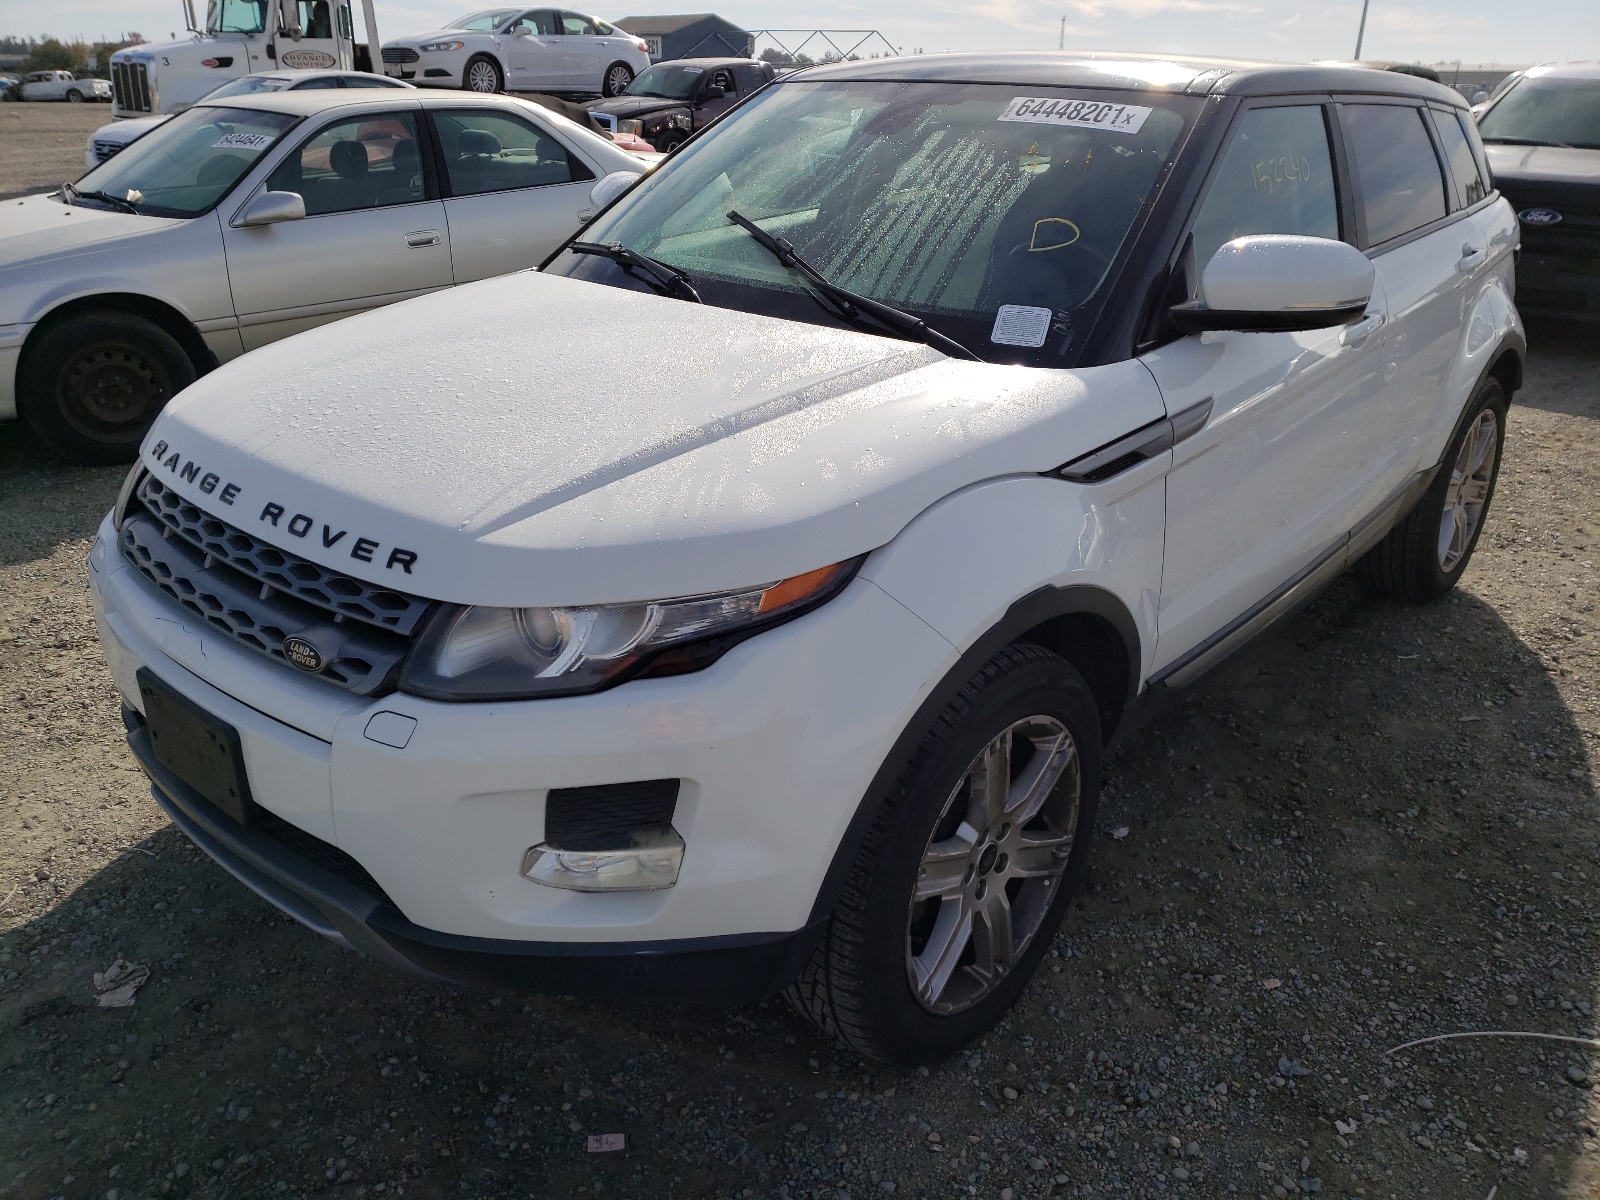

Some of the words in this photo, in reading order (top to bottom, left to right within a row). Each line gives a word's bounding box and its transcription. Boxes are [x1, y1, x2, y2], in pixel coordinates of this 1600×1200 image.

[162, 56, 170, 66] 3
[283, 54, 335, 62] ADVANCED
[1027, 217, 1080, 252] D
[151, 439, 242, 506] RANGE
[259, 502, 419, 575] ROVER
